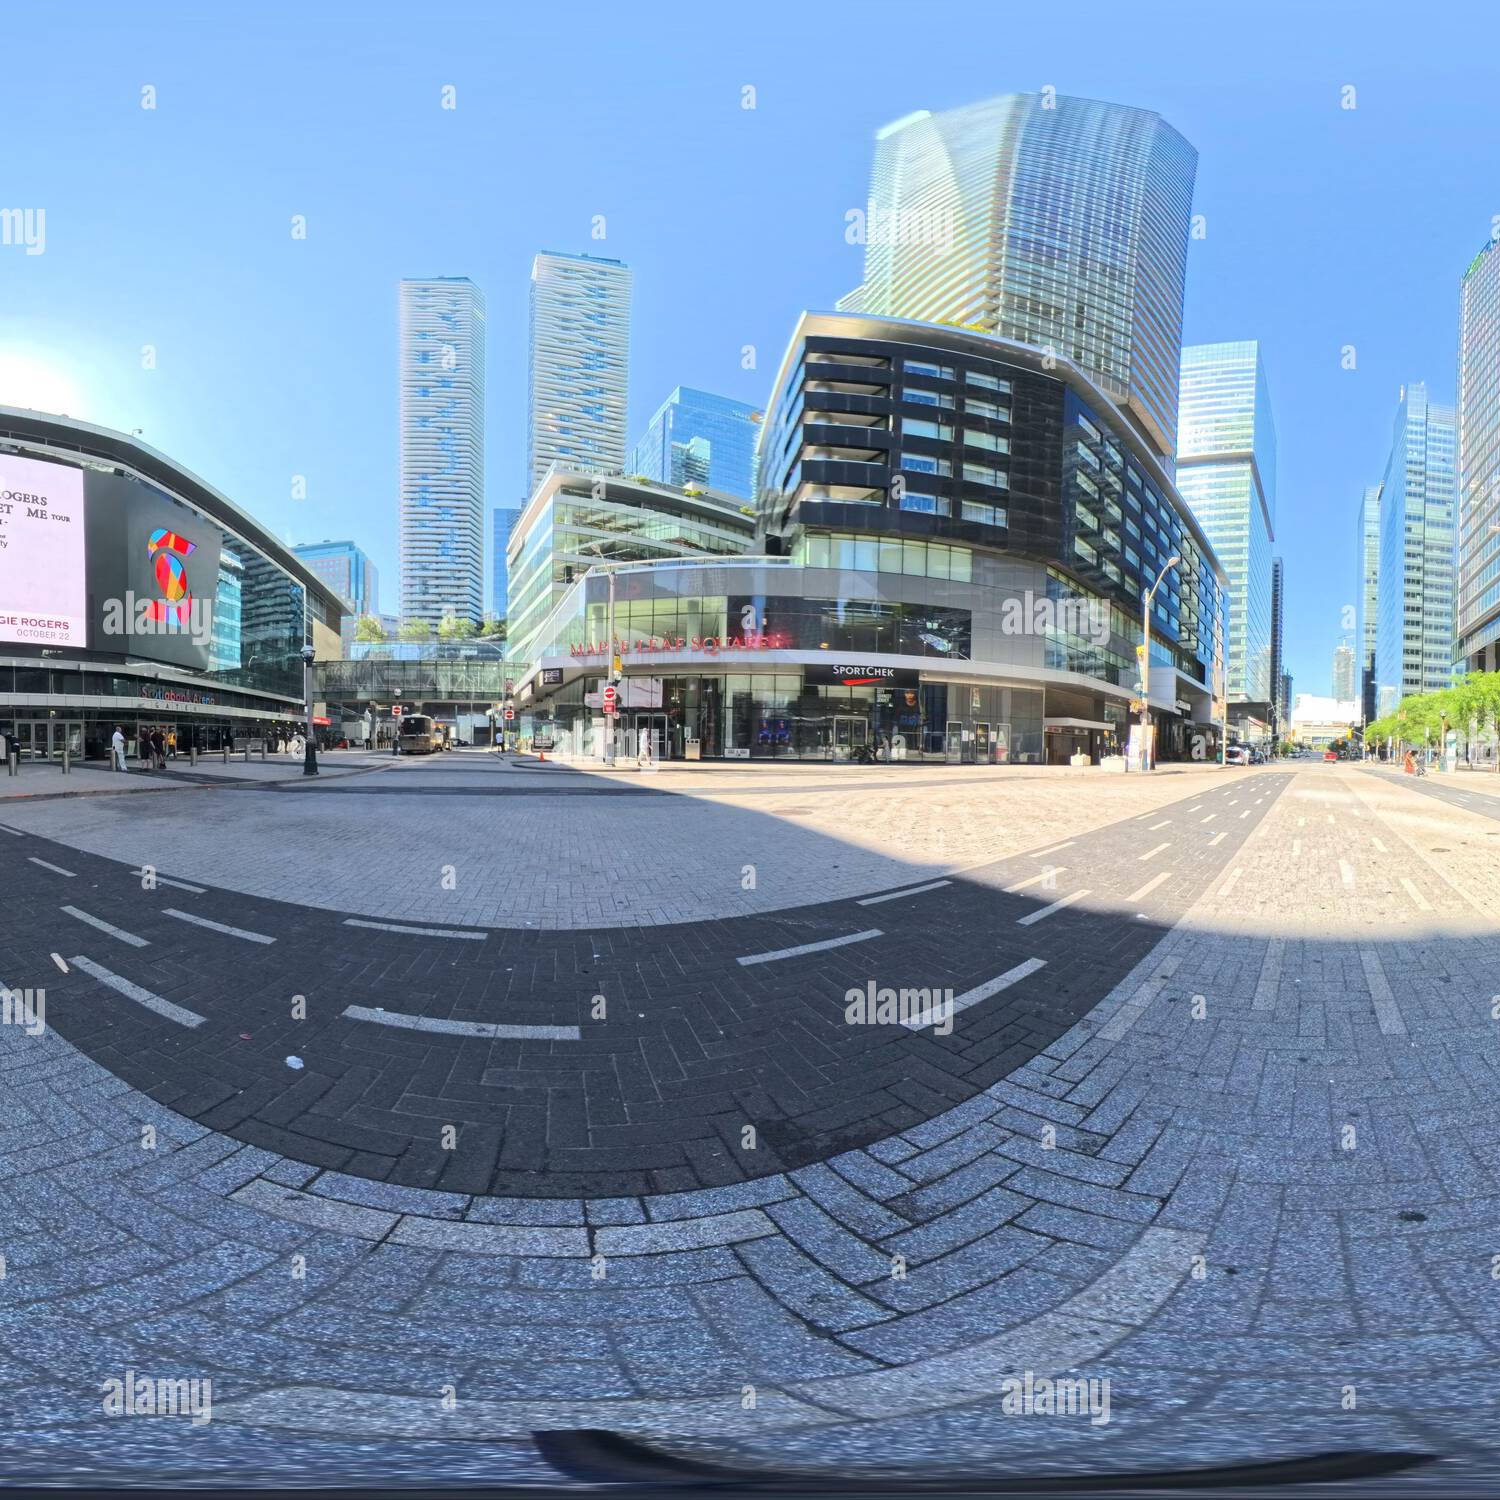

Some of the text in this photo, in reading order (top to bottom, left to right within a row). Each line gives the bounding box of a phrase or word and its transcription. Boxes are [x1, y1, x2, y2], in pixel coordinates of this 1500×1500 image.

[0, 490, 48, 506] OGERS
[27, 507, 70, 522] ME TOUR
[21, 617, 69, 630] ROGERS
[17, 629, 70, 641] OCTOBER 22
[570, 636, 770, 657] MAPE LEAF SQUARE
